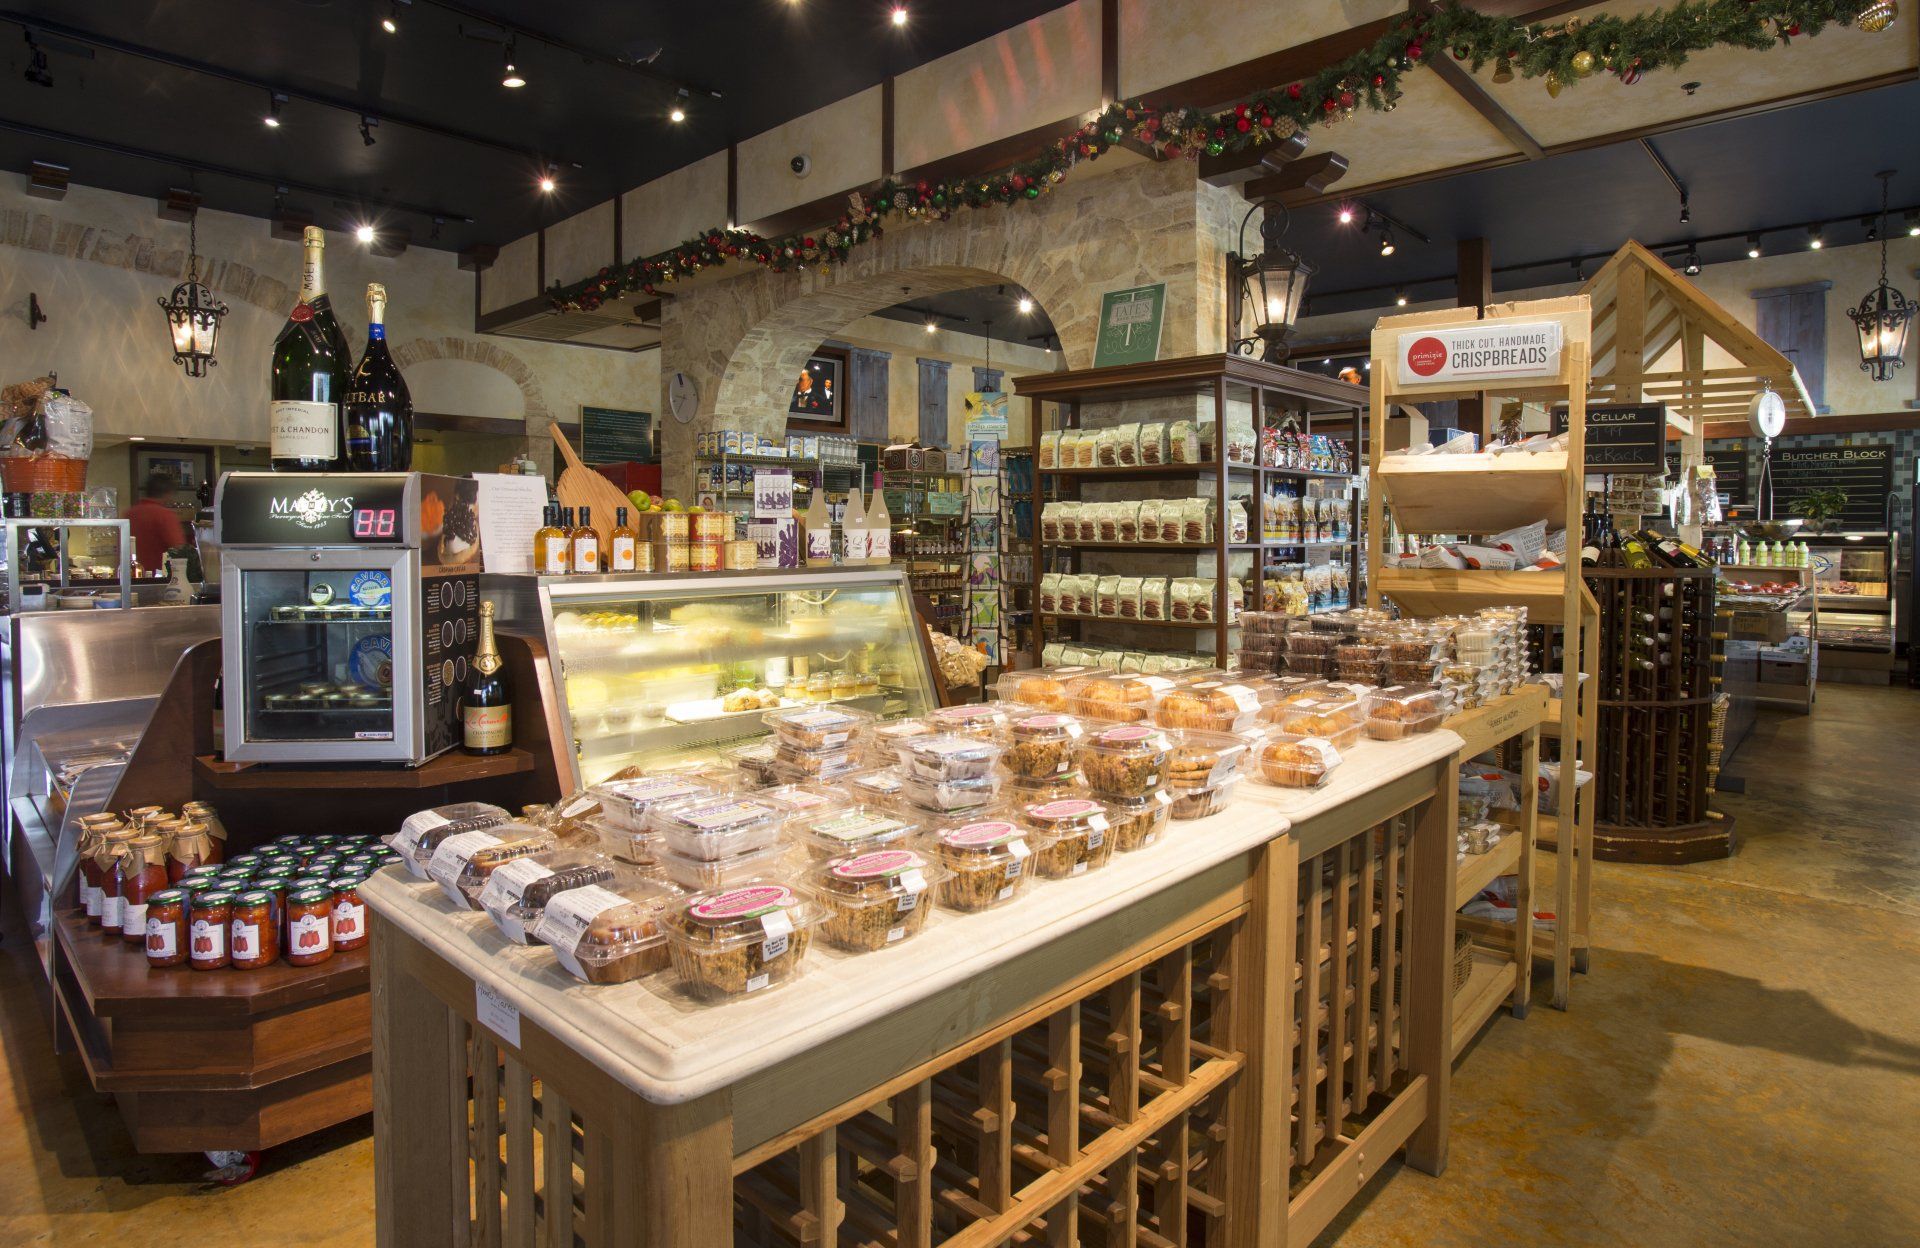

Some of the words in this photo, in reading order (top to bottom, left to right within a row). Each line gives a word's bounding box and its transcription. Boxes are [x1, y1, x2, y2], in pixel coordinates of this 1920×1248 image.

[1452, 339, 1475, 350] THICK
[1499, 334, 1546, 347] HANDMADE
[1452, 347, 1547, 369] CRISPBREADS
[1592, 413, 1636, 422] CELLAR
[287, 426, 329, 434] CHANDON
[1782, 452, 1839, 461] BUTCHER
[1844, 450, 1887, 459] BLOCK
[351, 571, 388, 592] CAVIAR
